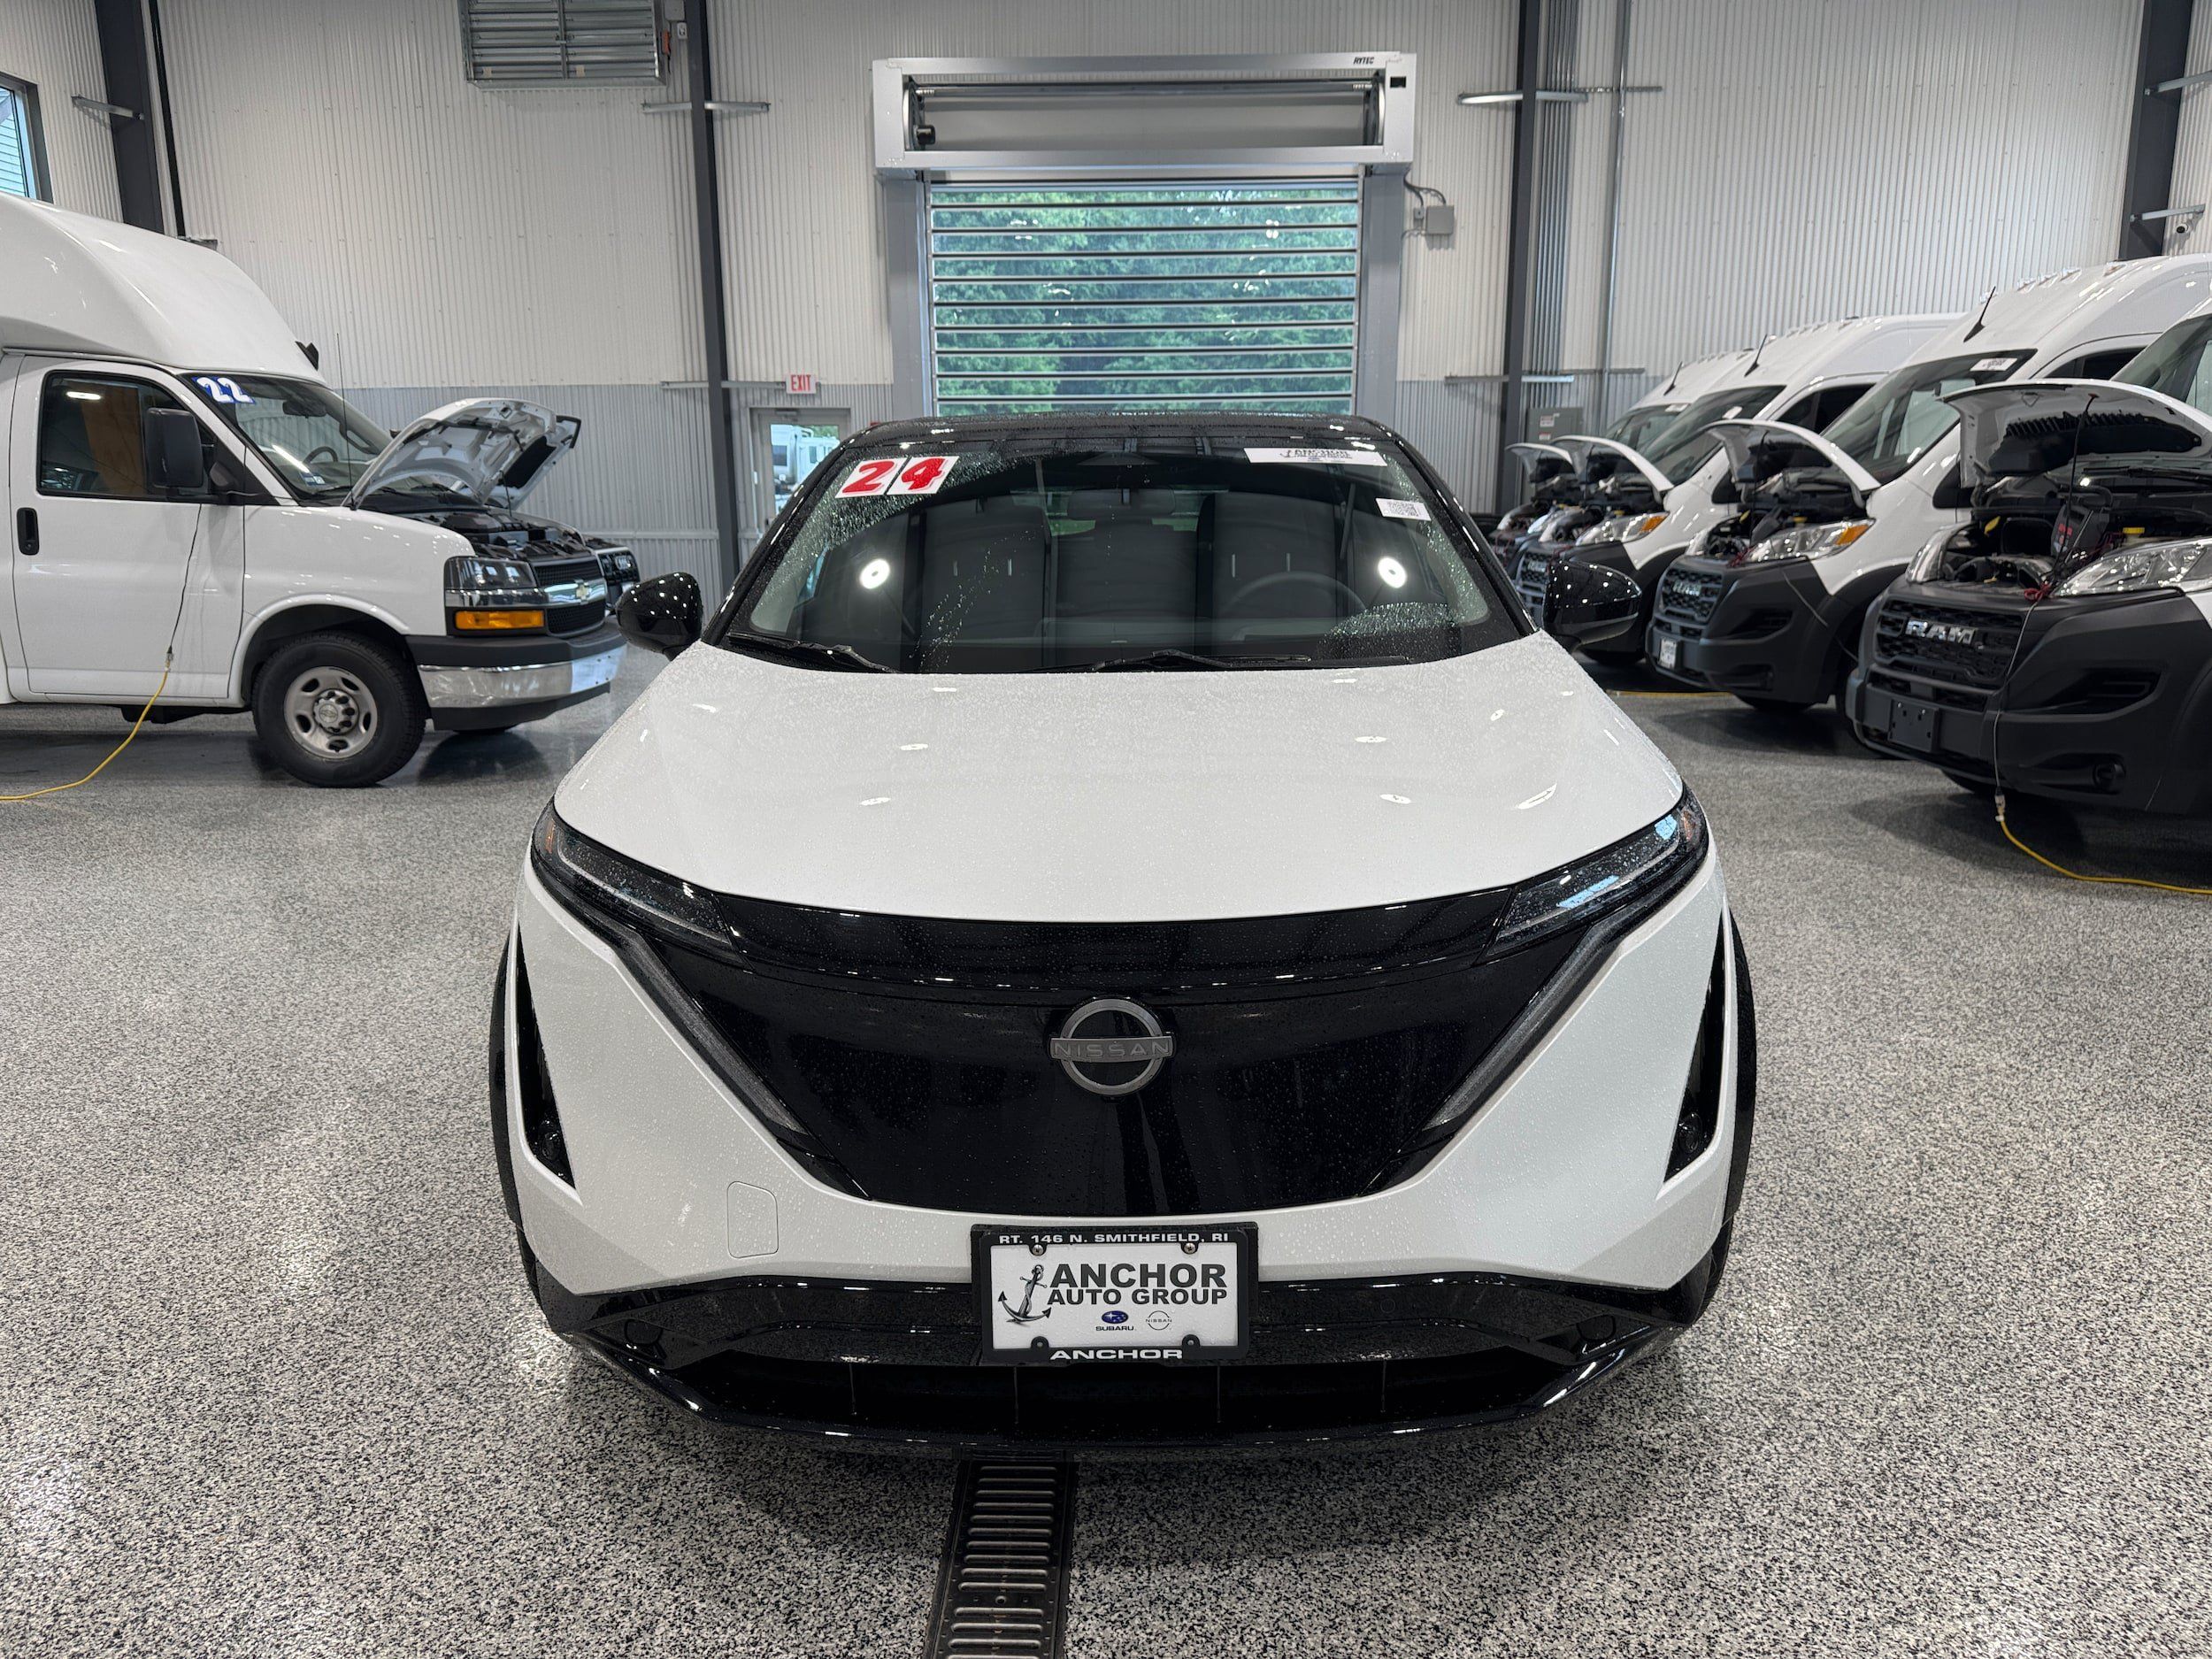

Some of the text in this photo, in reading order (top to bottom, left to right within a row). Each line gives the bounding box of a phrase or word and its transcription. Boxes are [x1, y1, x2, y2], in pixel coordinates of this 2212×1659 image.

[196, 377, 254, 403] 22
[790, 374, 811, 391] EXIT
[841, 457, 946, 493] 24
[1905, 618, 1978, 644] RAM
[1053, 1040, 1170, 1059] NISSAN
[999, 1235, 1023, 1244] RT.
[1031, 1234, 1063, 1243] 146
[1070, 1234, 1087, 1243] N.
[1211, 1233, 1228, 1241] RI
[1049, 1263, 1227, 1288] ANCHOR
[1047, 1288, 1227, 1305] AUTO GROUP
[1050, 1349, 1183, 1360] ANCHOR
